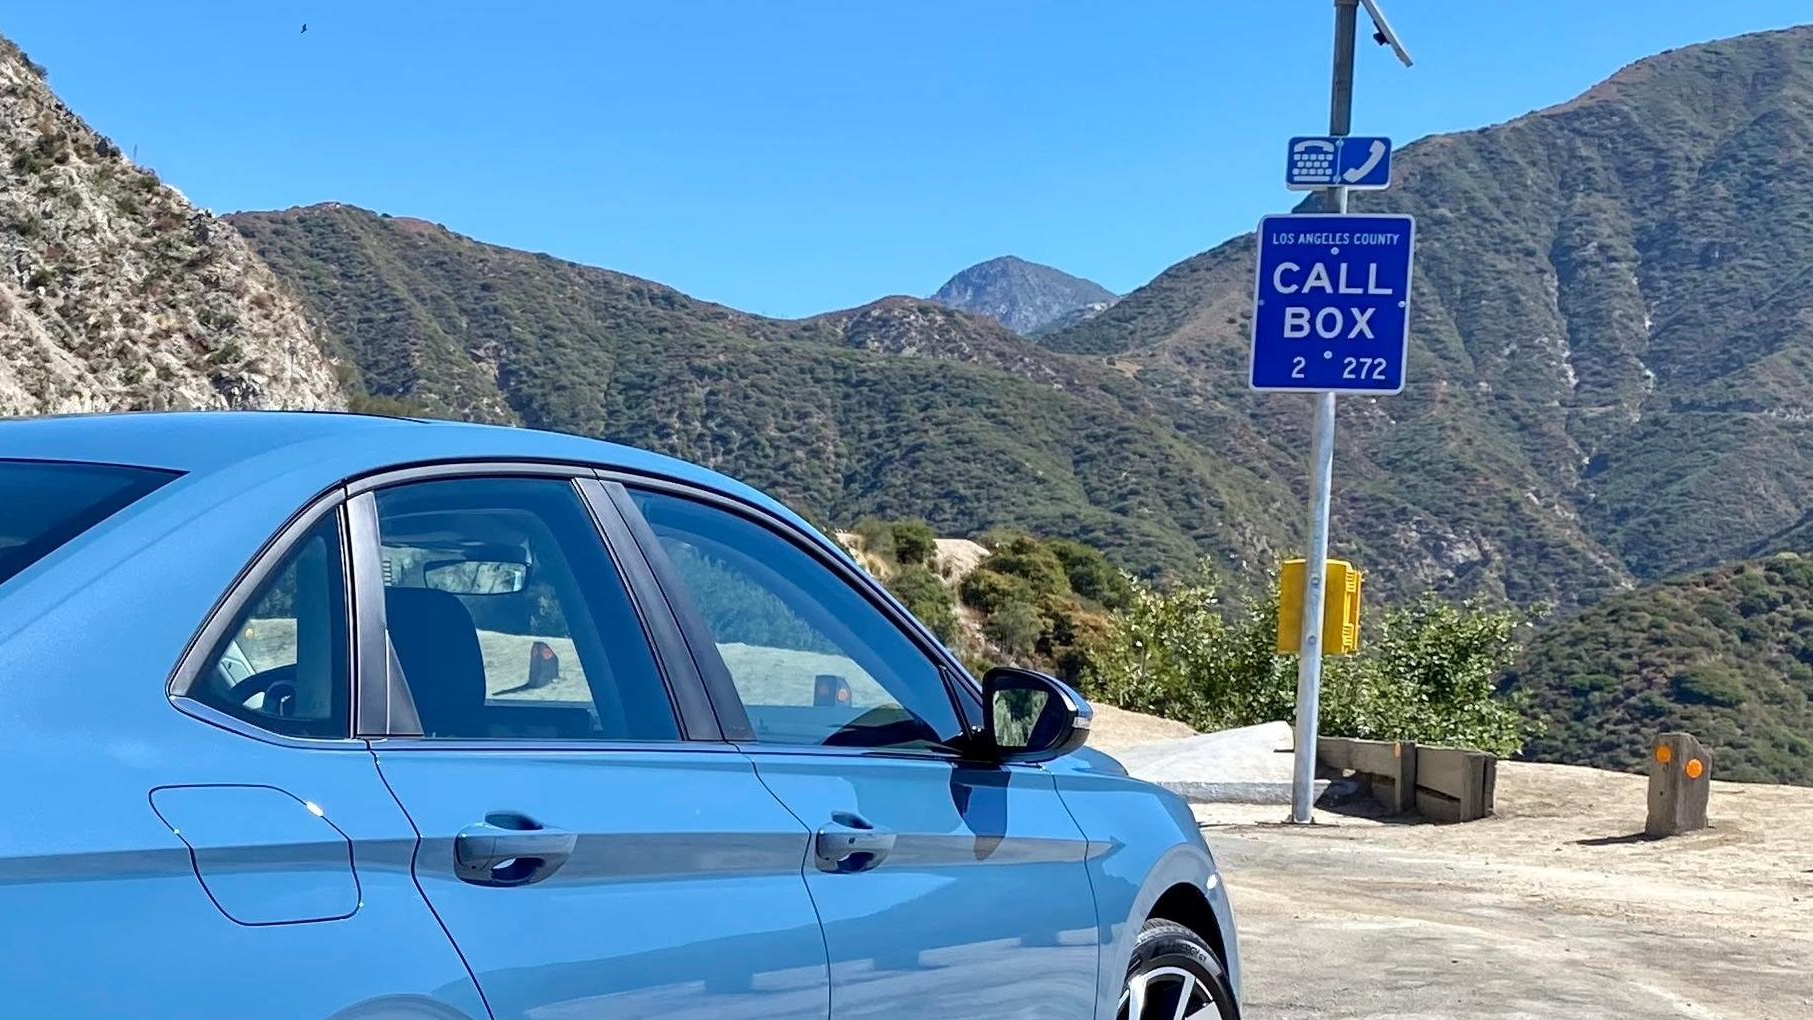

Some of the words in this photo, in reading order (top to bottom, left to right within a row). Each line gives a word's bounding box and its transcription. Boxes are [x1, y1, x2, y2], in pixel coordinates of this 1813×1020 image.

[1273, 233, 1295, 245] LOS
[1298, 233, 1350, 245] ANGELES
[1353, 233, 1400, 245] COUNTY
[1273, 262, 1393, 295] CALL
[1283, 306, 1376, 339] BOX
[1291, 356, 1305, 379] 2
[1342, 357, 1387, 380] 272
